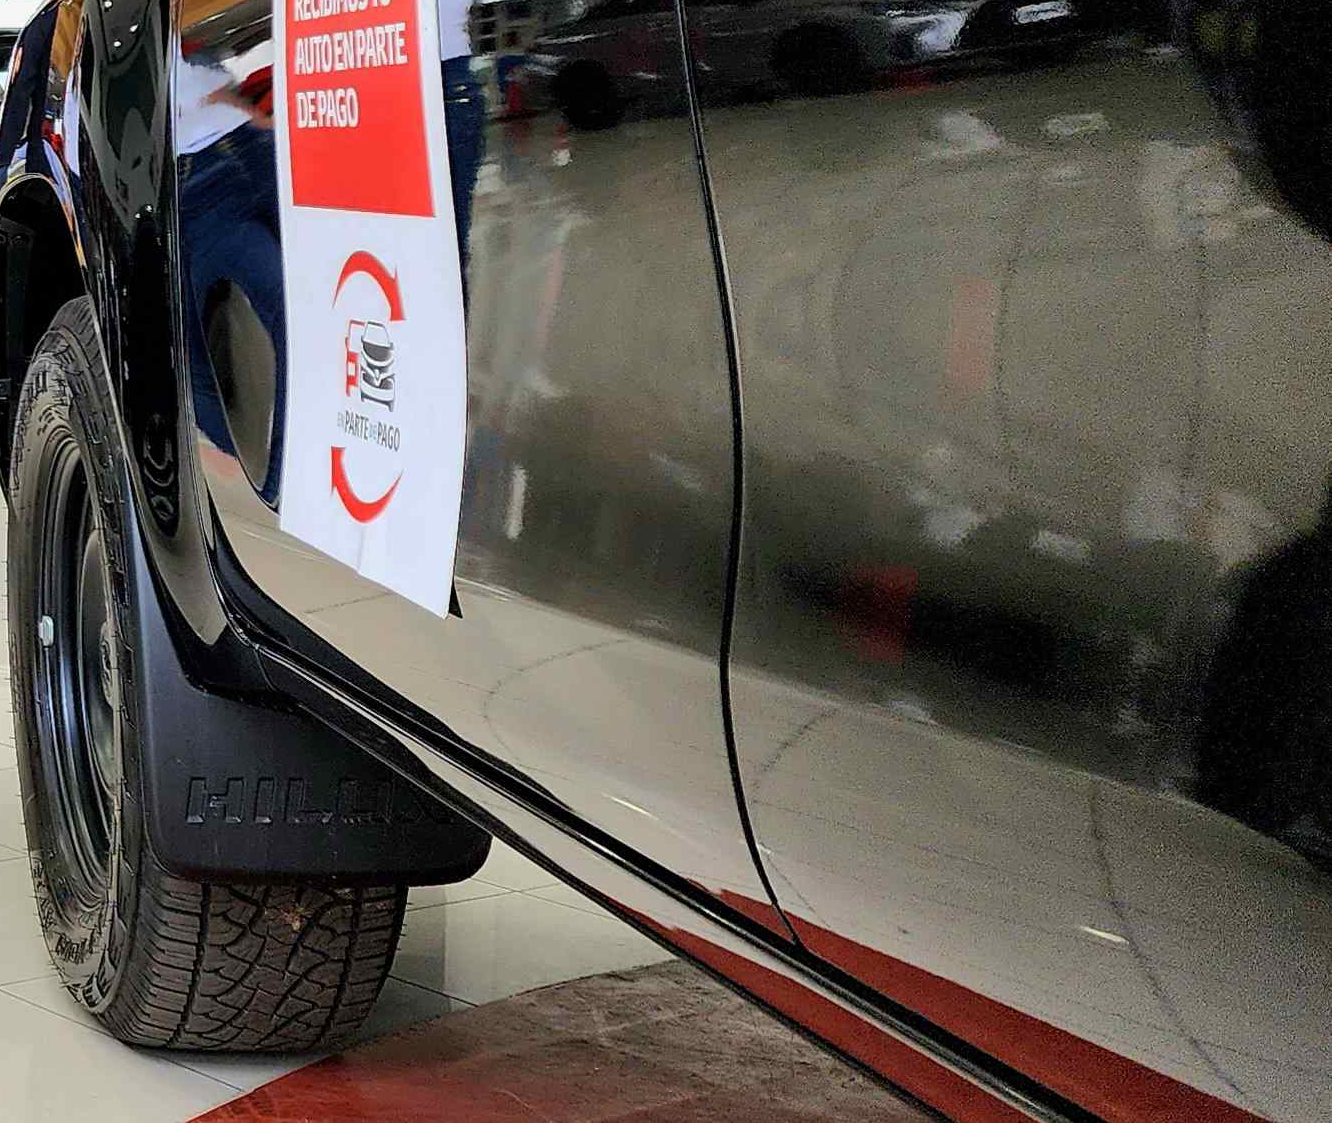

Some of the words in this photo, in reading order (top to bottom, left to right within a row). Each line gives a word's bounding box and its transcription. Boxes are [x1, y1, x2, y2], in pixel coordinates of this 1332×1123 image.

[294, 34, 333, 76] AUTO
[332, 31, 355, 72] EN
[353, 22, 409, 69] PARTE
[296, 90, 319, 129] DE
[317, 87, 360, 129] PAGO
[344, 409, 370, 441] PARTE
[377, 421, 402, 453] PAGO
